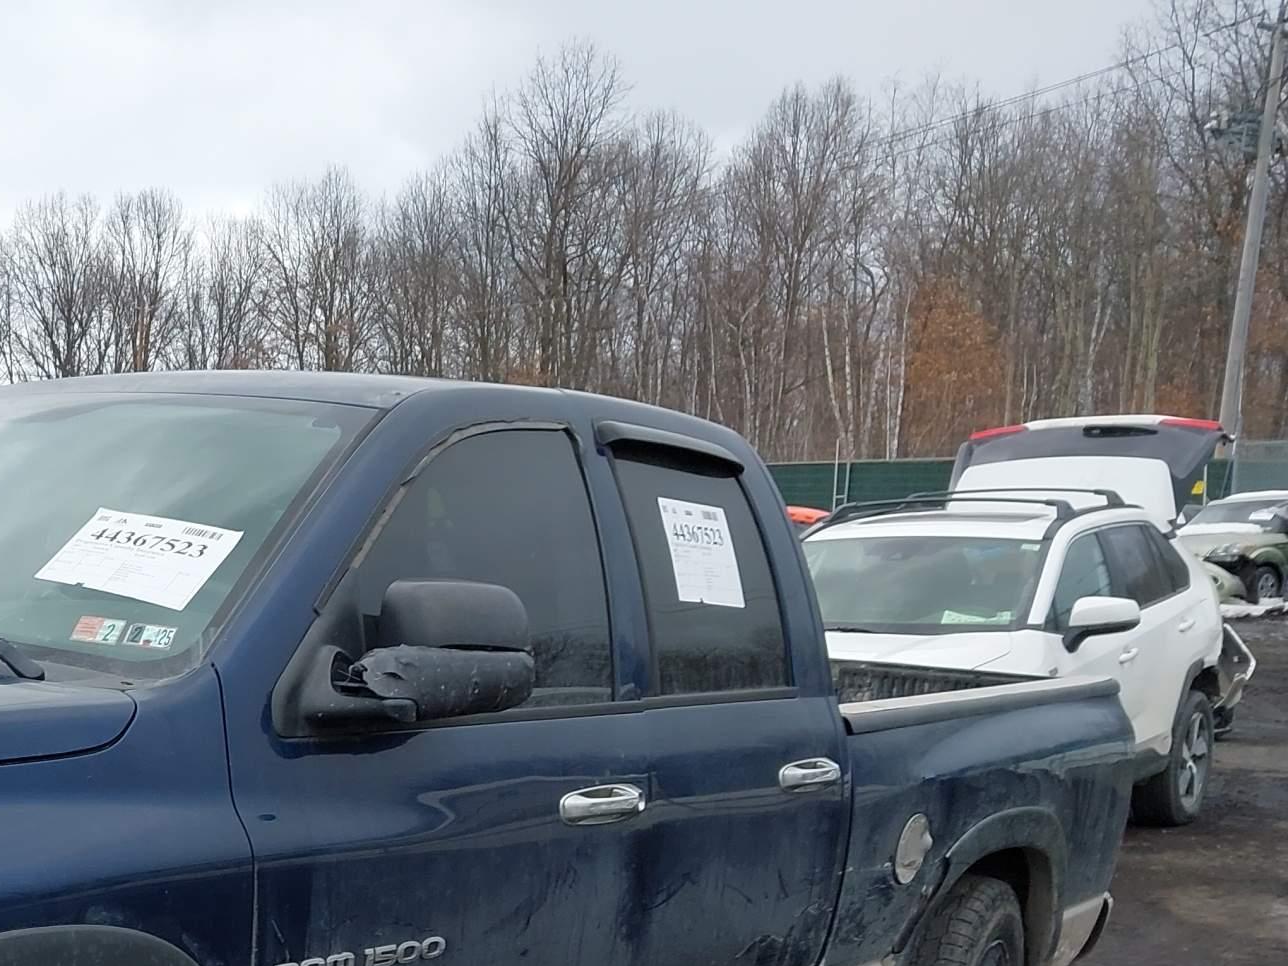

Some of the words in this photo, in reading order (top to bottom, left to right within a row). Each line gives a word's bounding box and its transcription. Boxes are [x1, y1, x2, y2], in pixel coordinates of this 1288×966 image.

[91, 527, 209, 559] 44367523
[673, 523, 724, 546] 44367523
[102, 623, 116, 642] 2
